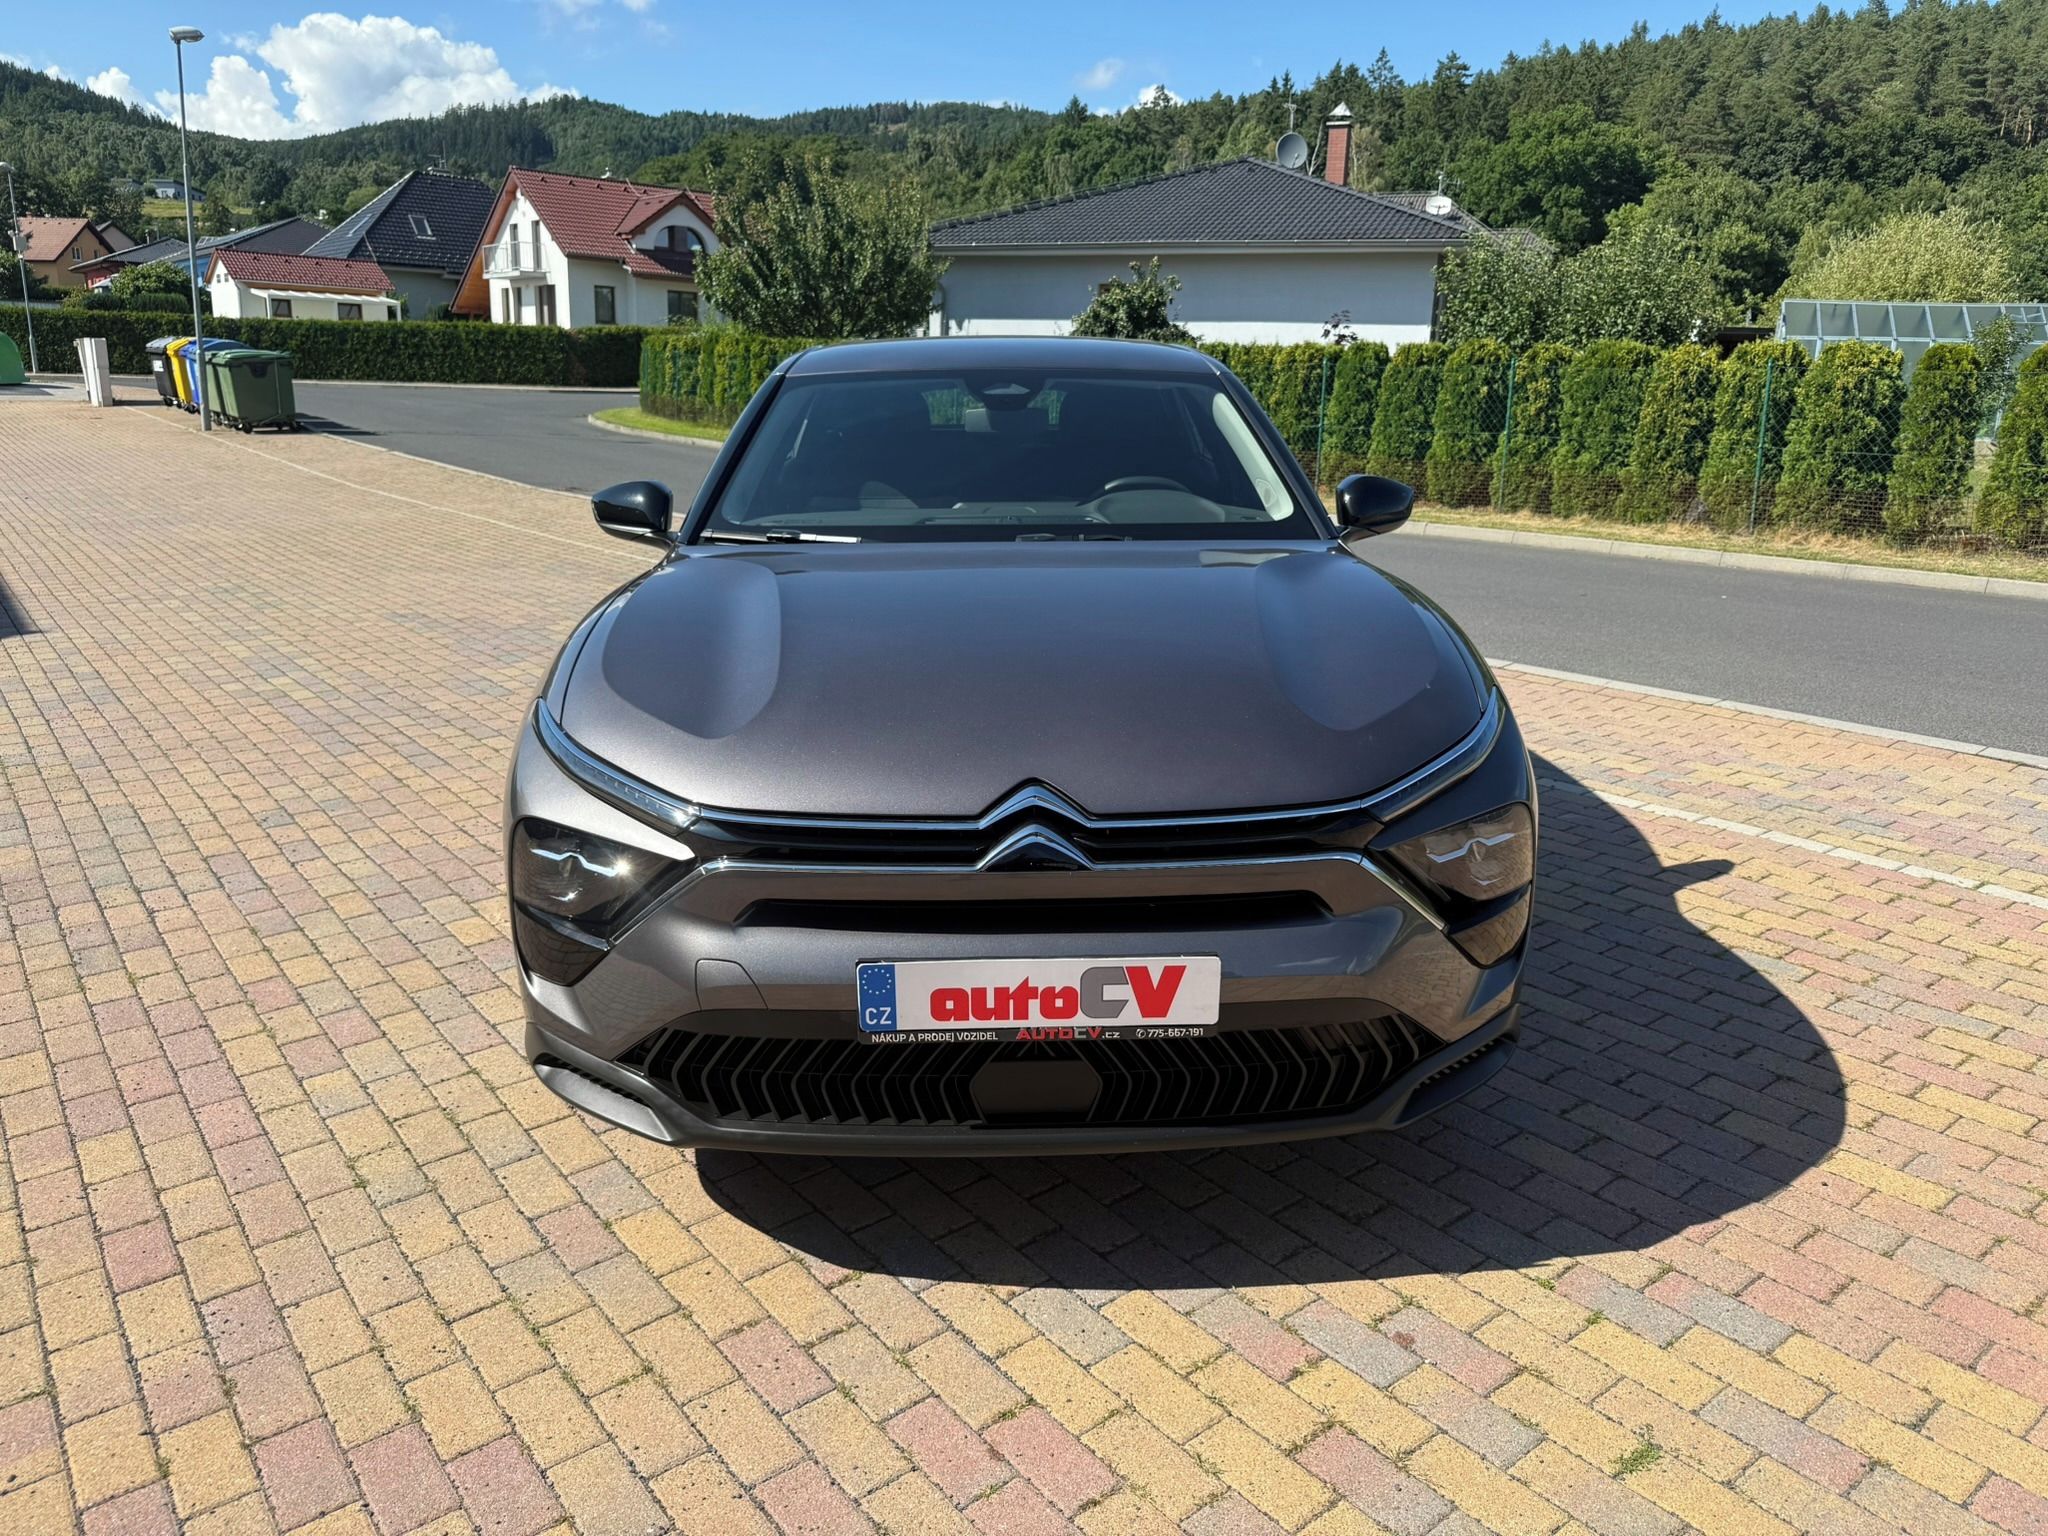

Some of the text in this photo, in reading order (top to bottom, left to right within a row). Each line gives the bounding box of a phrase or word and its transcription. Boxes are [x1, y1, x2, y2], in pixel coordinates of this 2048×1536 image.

[930, 965, 1187, 1021] autoCV
[865, 1007, 892, 1025] CZ
[871, 1031, 999, 1043] NÁKUP A PRODEJ VOZIDEL
[1147, 1028, 1204, 1038] 775-667-191
